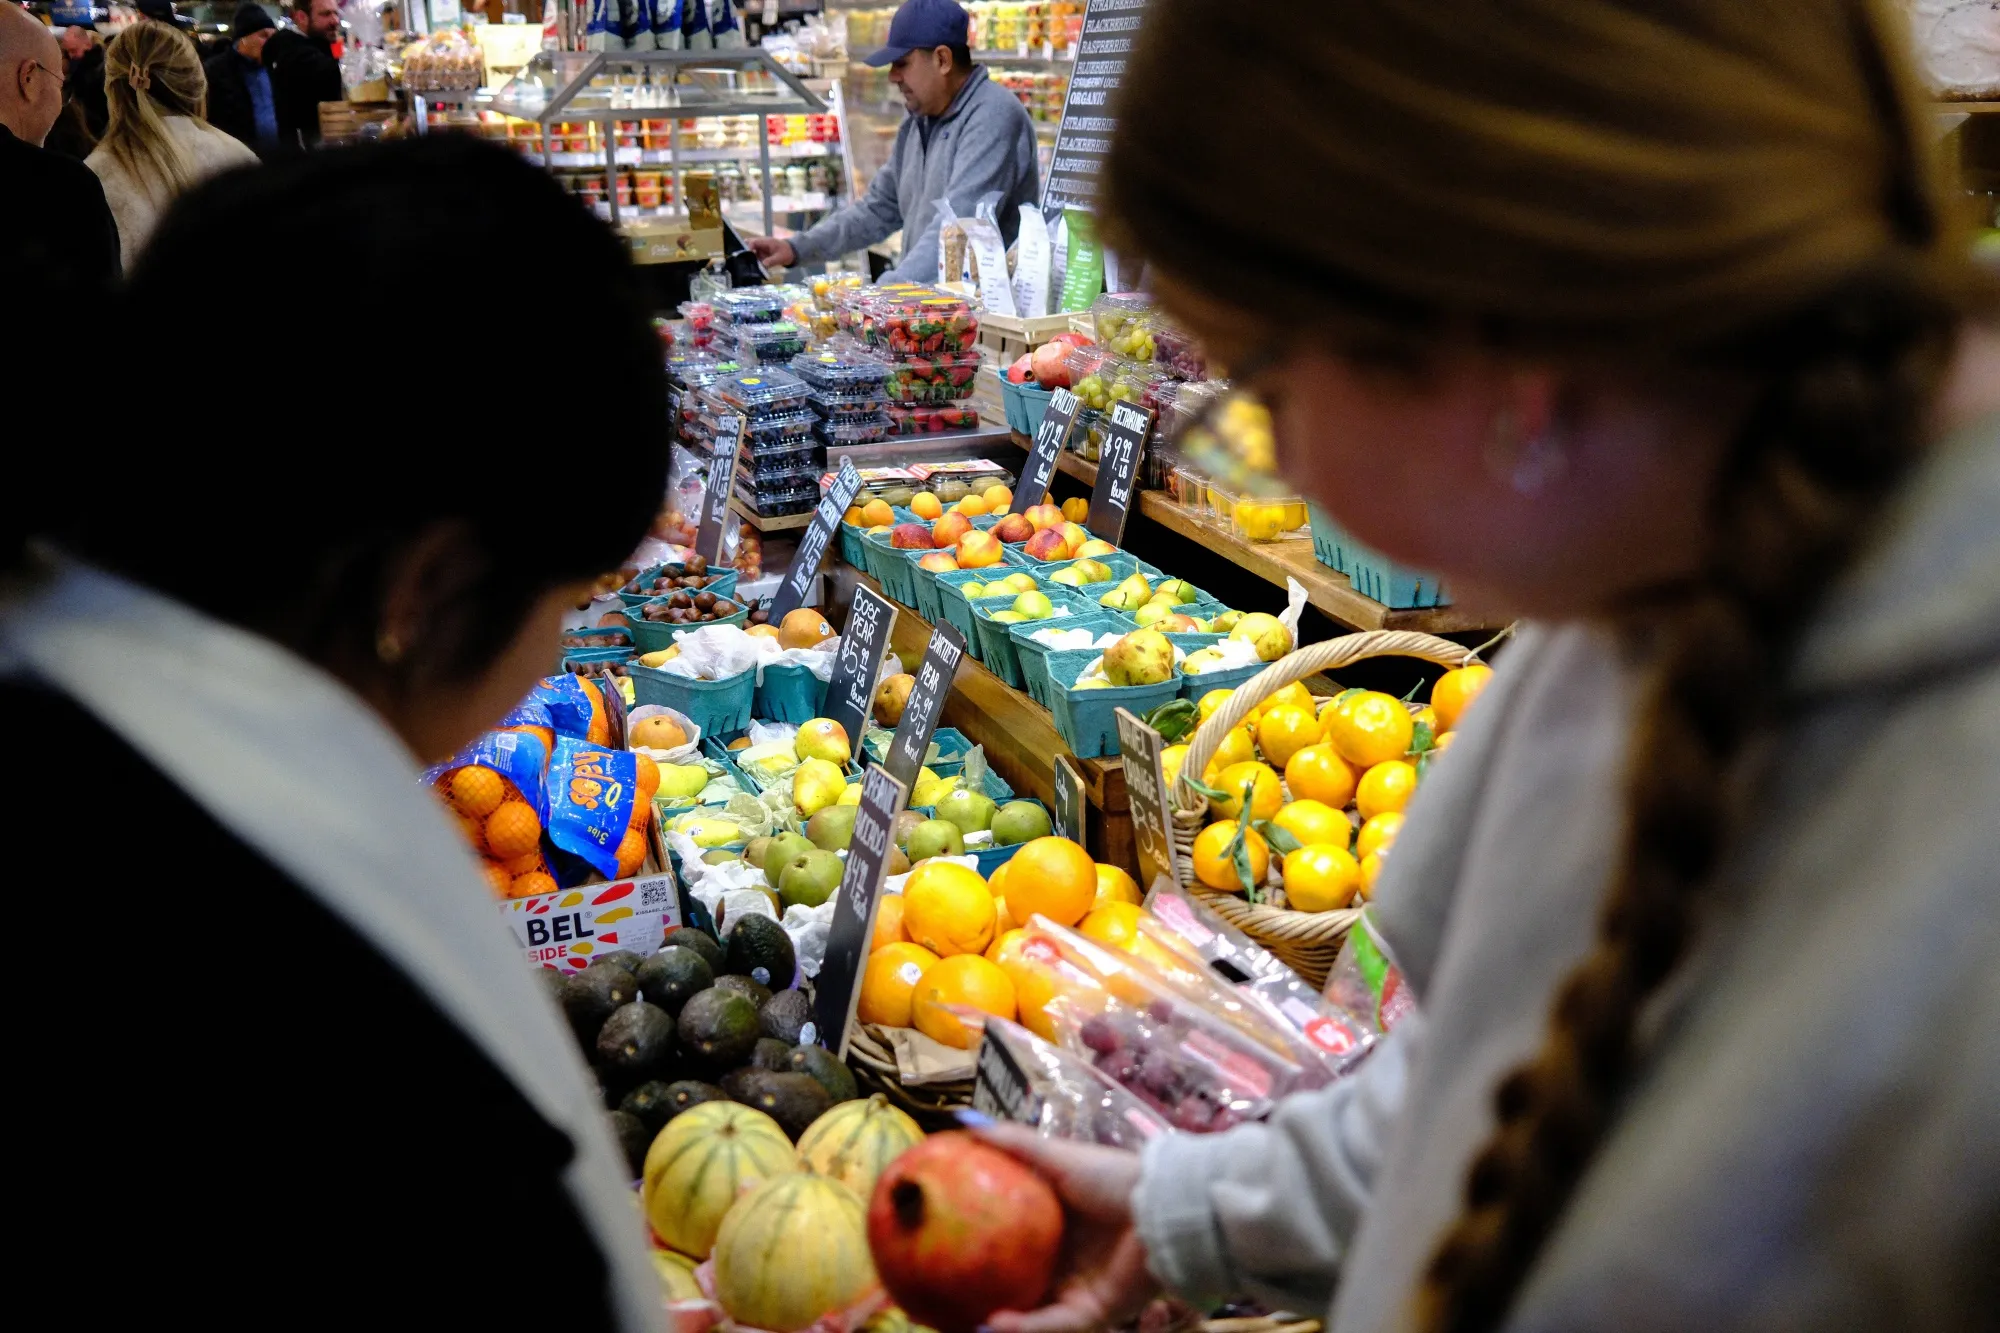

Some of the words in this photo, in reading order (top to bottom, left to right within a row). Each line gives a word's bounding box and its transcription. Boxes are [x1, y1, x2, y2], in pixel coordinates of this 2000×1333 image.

[1085, 16, 1141, 33] BLACKBERRIES
[1081, 38, 1131, 54] RASPBERRIES
[1076, 60, 1127, 75] BLUEBERRIES
[1070, 91, 1107, 105] ORGANIC
[1063, 116, 1118, 131] STRAWBERRIES
[1049, 386, 1079, 417] APRICOT
[1111, 404, 1148, 435] NECTARINE
[839, 462, 861, 494] FRESH
[1118, 464, 1128, 479] LB
[1110, 479, 1129, 503] Pound
[850, 613, 875, 646] PEAR
[928, 628, 962, 669] BARTLETT
[856, 671, 866, 688] LB
[920, 661, 940, 695] PEAR
[850, 683, 868, 709] Pound
[915, 722, 927, 740] LB
[568, 751, 616, 810] halos
[586, 825, 602, 840] lbs
[598, 831, 609, 846] 3
[526, 911, 595, 947] BEL
